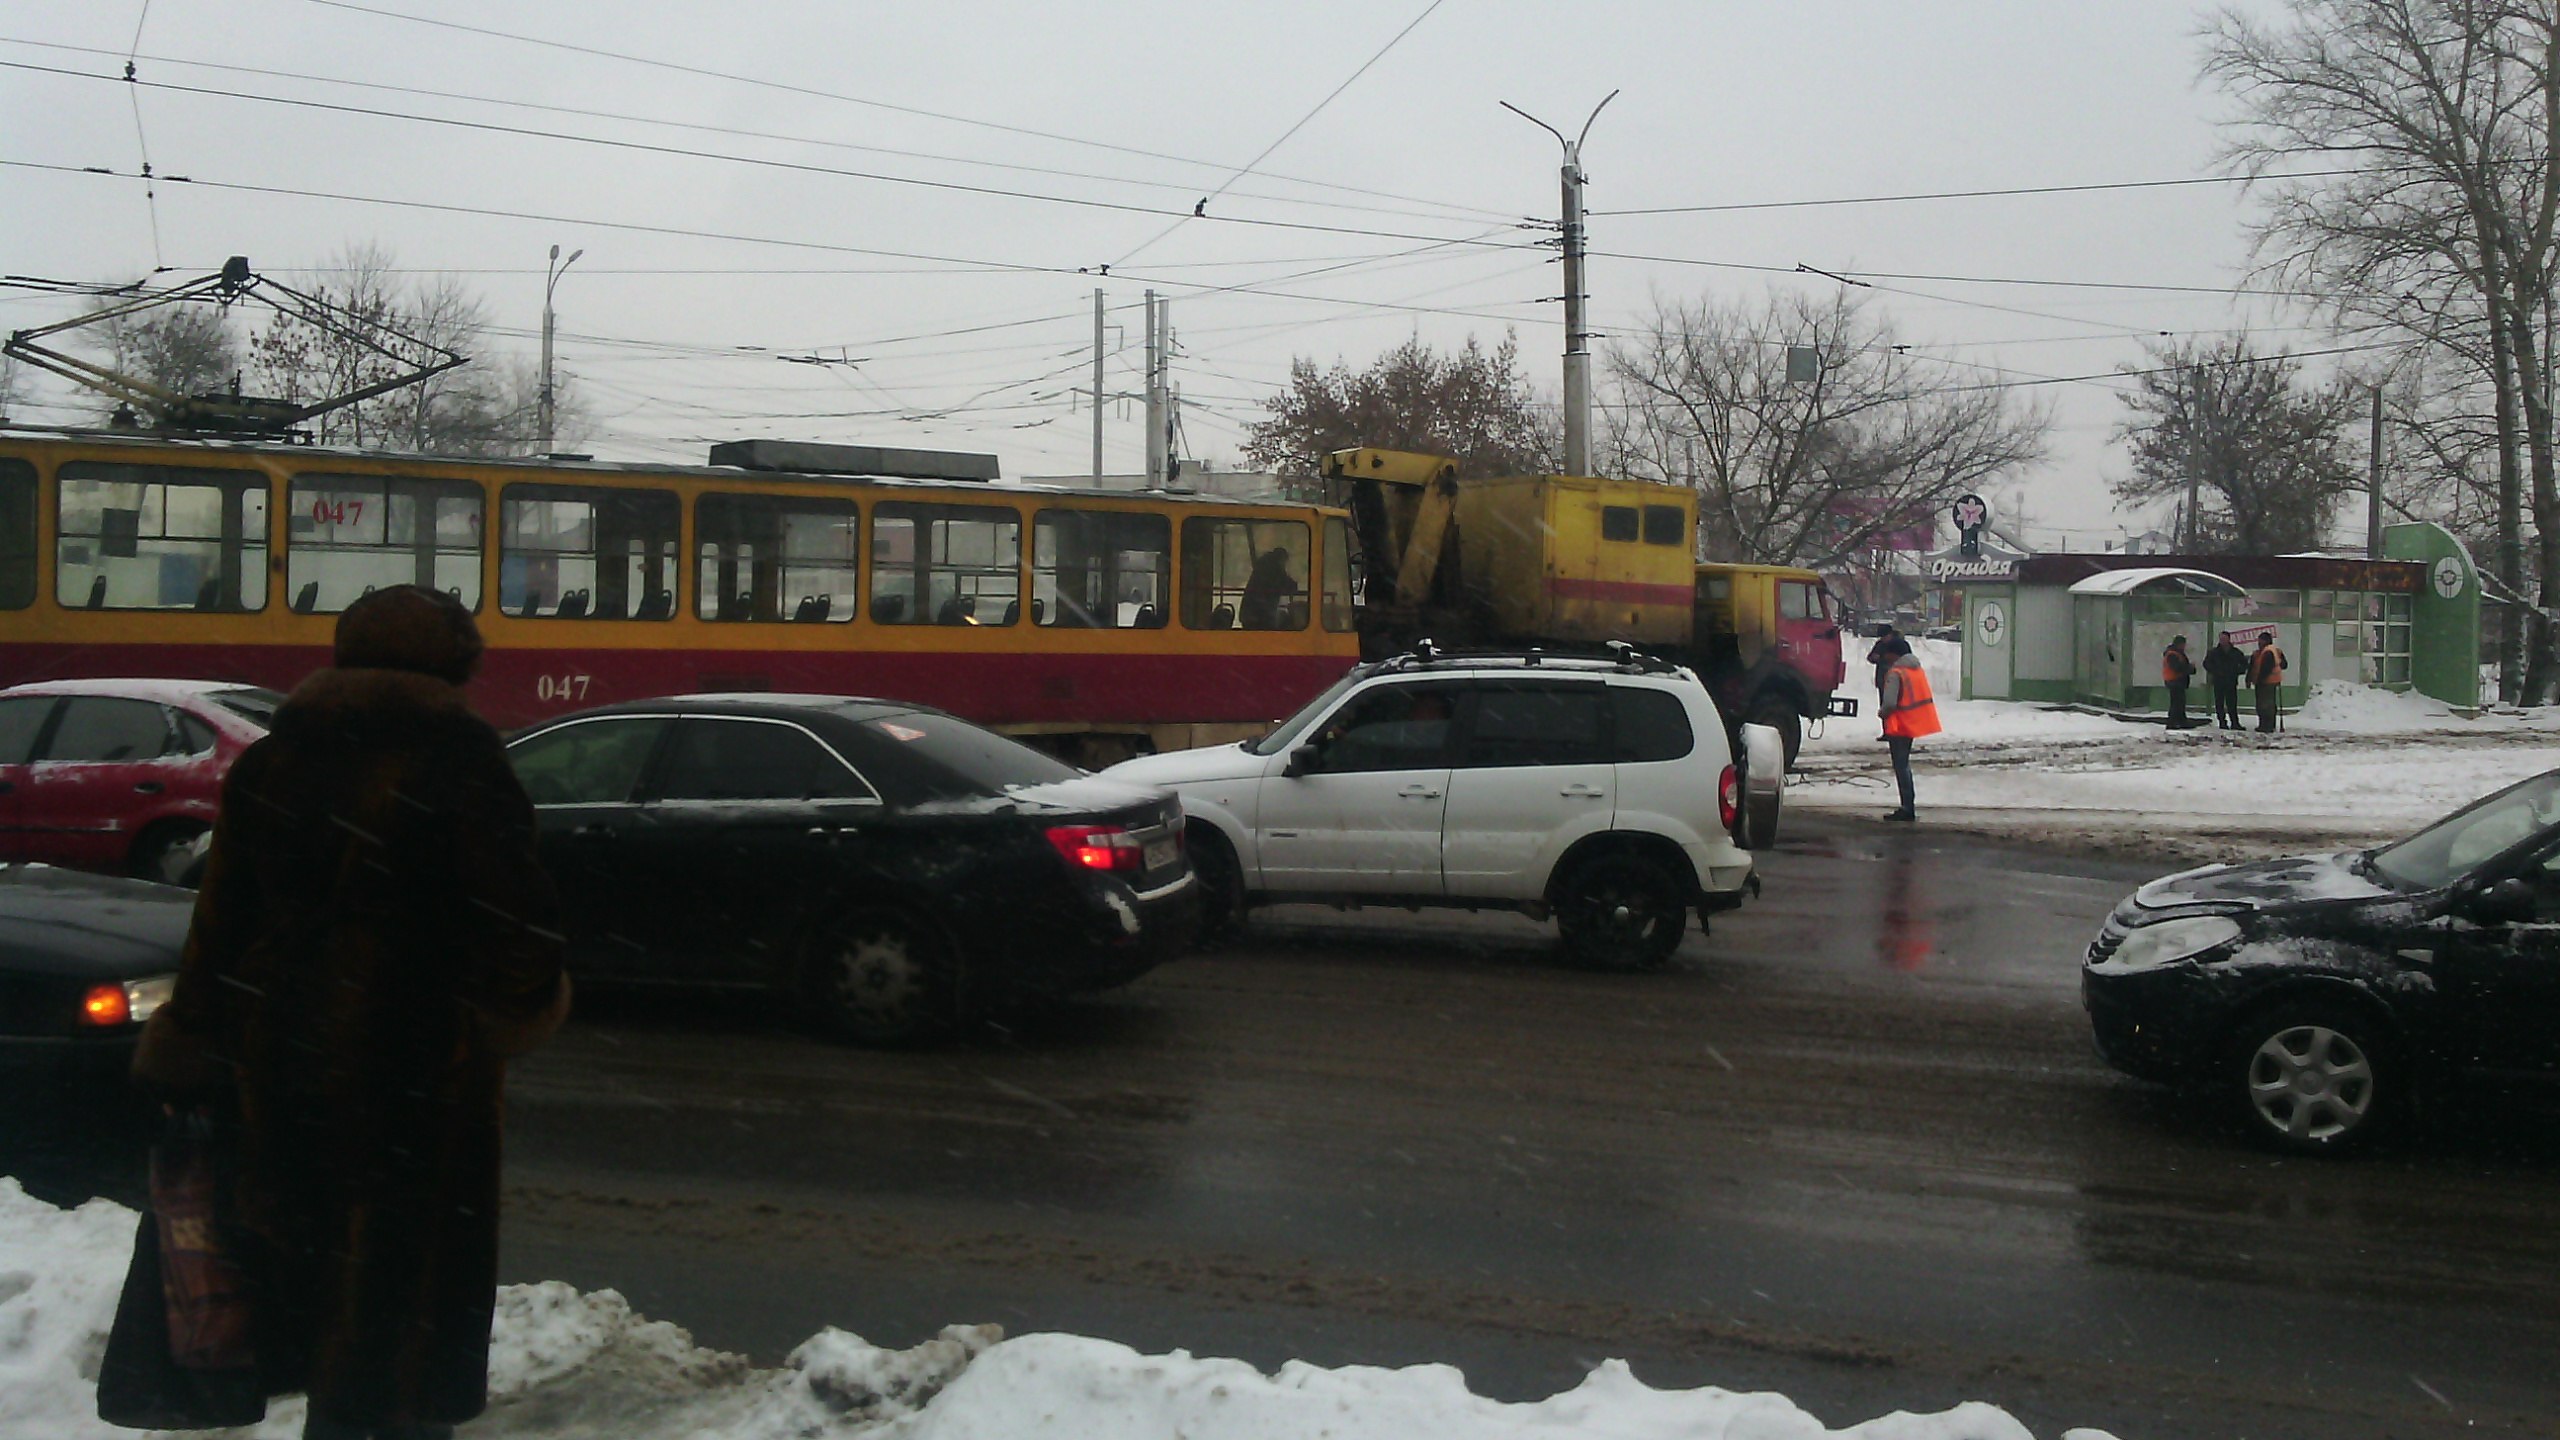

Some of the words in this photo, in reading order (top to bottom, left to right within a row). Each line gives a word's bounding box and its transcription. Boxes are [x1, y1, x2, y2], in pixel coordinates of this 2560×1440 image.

[313, 499, 363, 526] 047
[1932, 554, 2012, 583] Орхидея
[537, 674, 591, 701] 047
